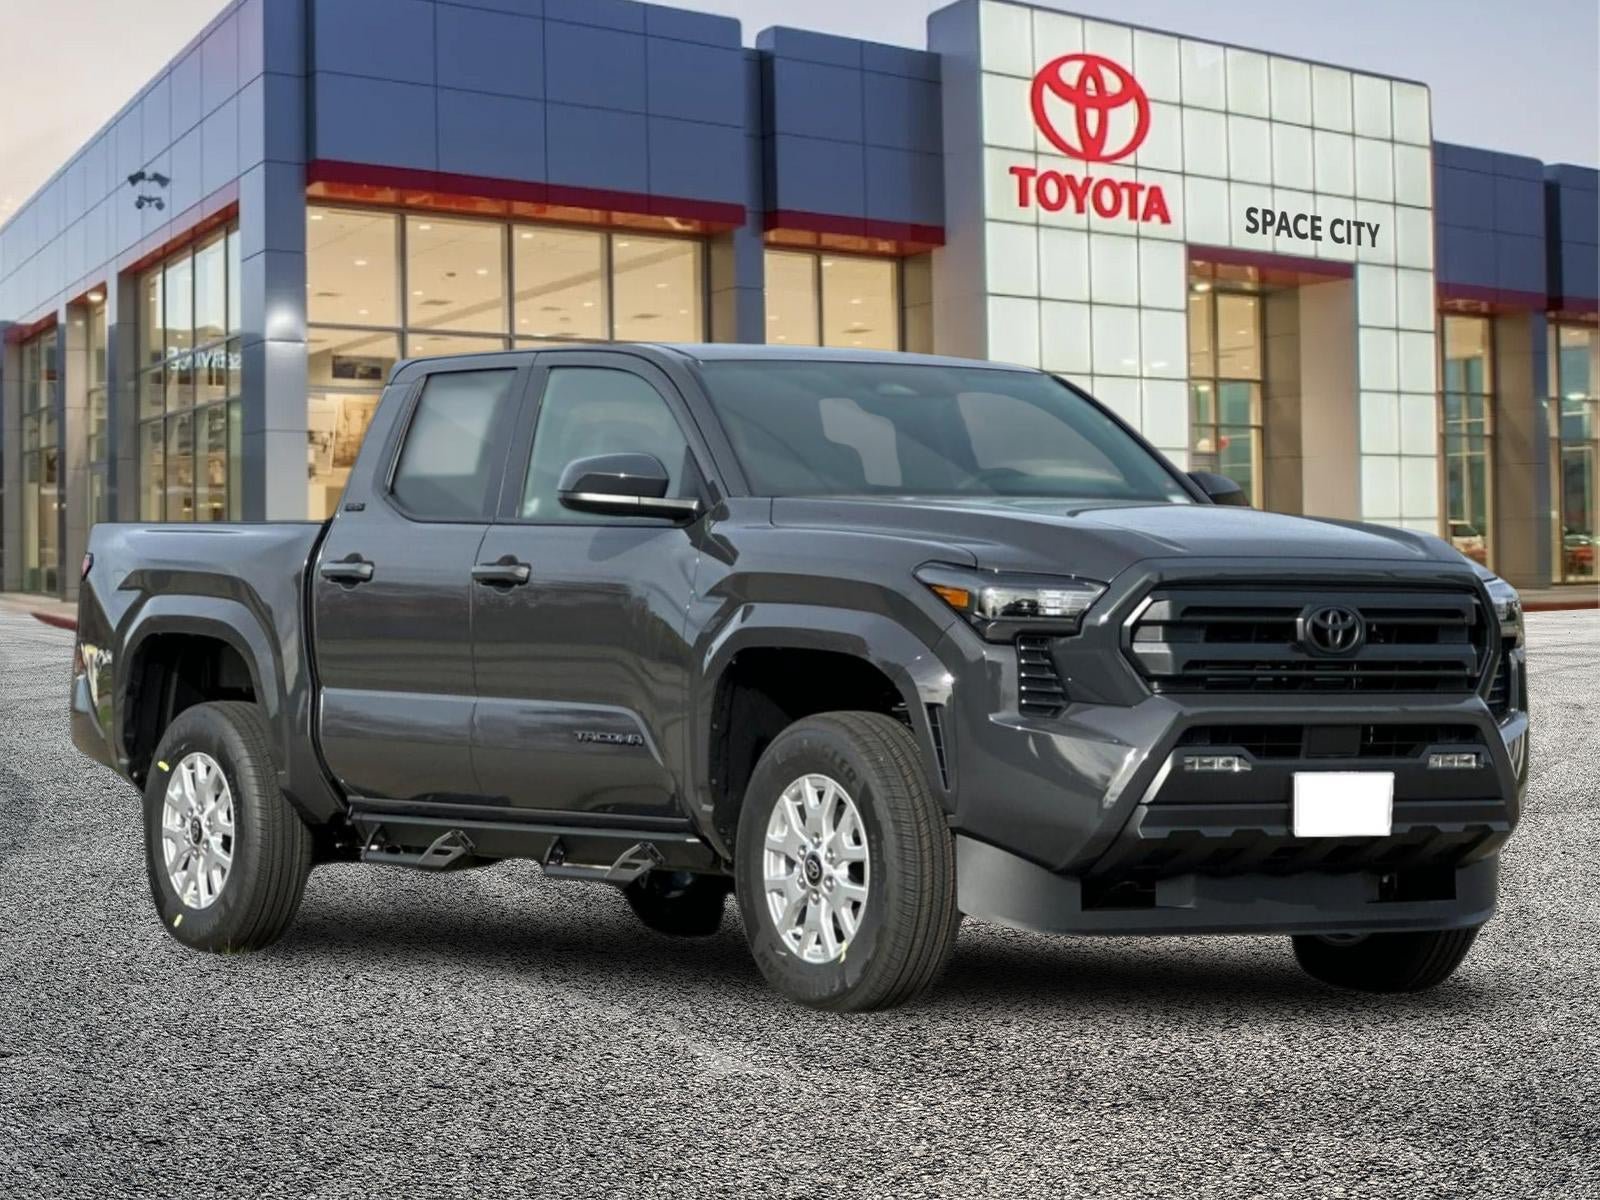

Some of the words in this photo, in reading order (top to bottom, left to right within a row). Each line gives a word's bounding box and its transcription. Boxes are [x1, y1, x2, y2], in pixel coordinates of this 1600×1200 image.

[1009, 166, 1171, 224] TOYOTA
[1246, 207, 1323, 241] SPACE
[1330, 218, 1381, 248] CITY
